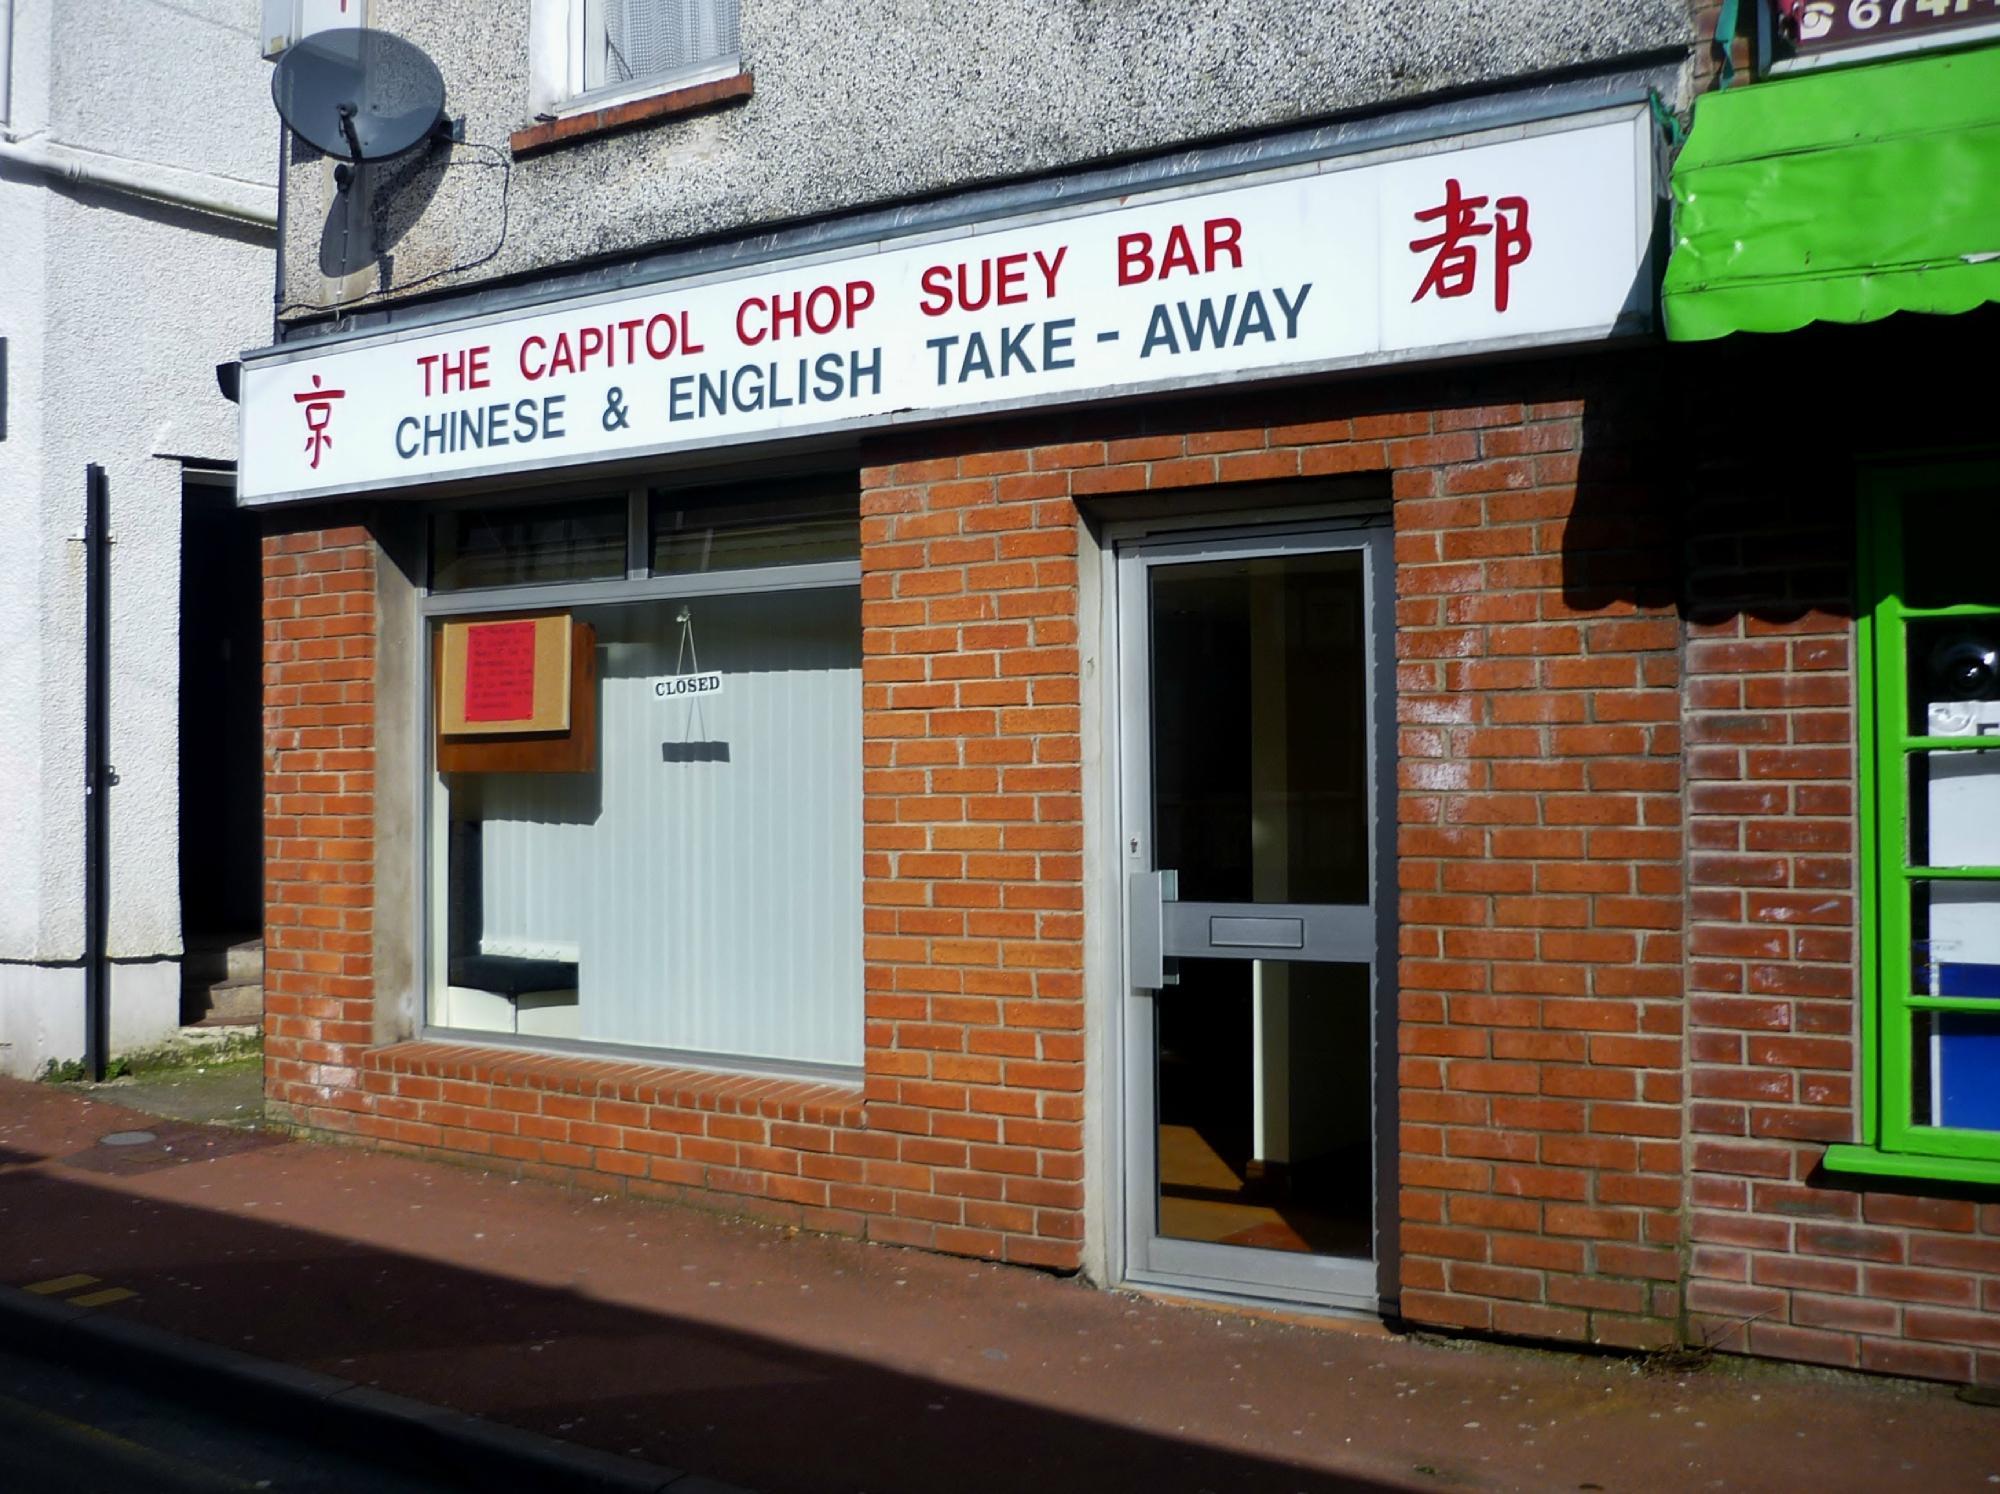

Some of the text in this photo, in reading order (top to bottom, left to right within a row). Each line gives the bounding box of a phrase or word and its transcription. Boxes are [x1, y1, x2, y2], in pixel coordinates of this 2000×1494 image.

[417, 217, 1243, 396] THE CAPITOL CHOP SUEY BAR
[1410, 178, 1533, 312] 都
[294, 374, 345, 469] 京
[395, 394, 566, 460] CHINESE
[602, 386, 629, 432] &
[669, 347, 882, 422] ENGLISH
[1139, 283, 1313, 359] AWAY
[655, 676, 721, 697] CLOSED
